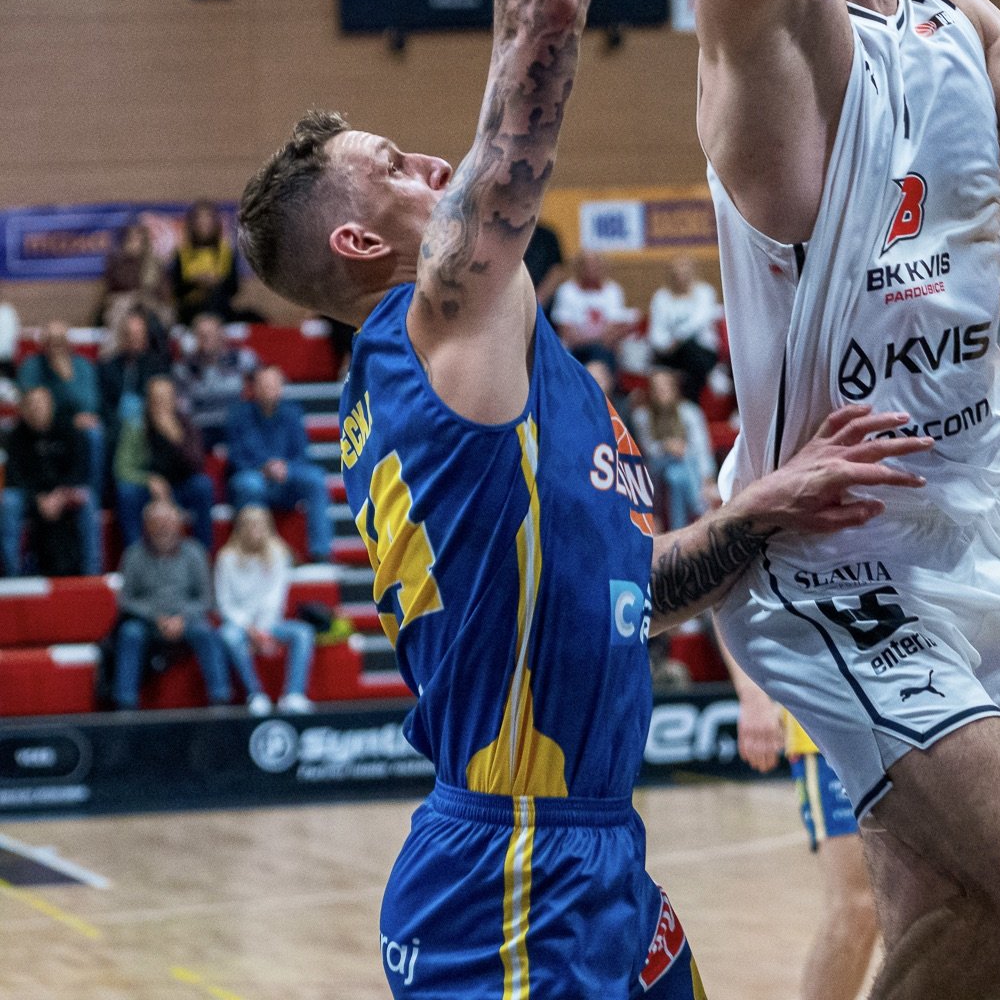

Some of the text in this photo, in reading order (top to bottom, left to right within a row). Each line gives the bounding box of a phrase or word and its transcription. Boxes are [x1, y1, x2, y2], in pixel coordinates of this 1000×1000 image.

[866, 252, 950, 292] BK KVIS
[885, 281, 945, 305] PARDUBICE
[885, 321, 991, 380] KVIS
[794, 561, 892, 589] SLAVIA
